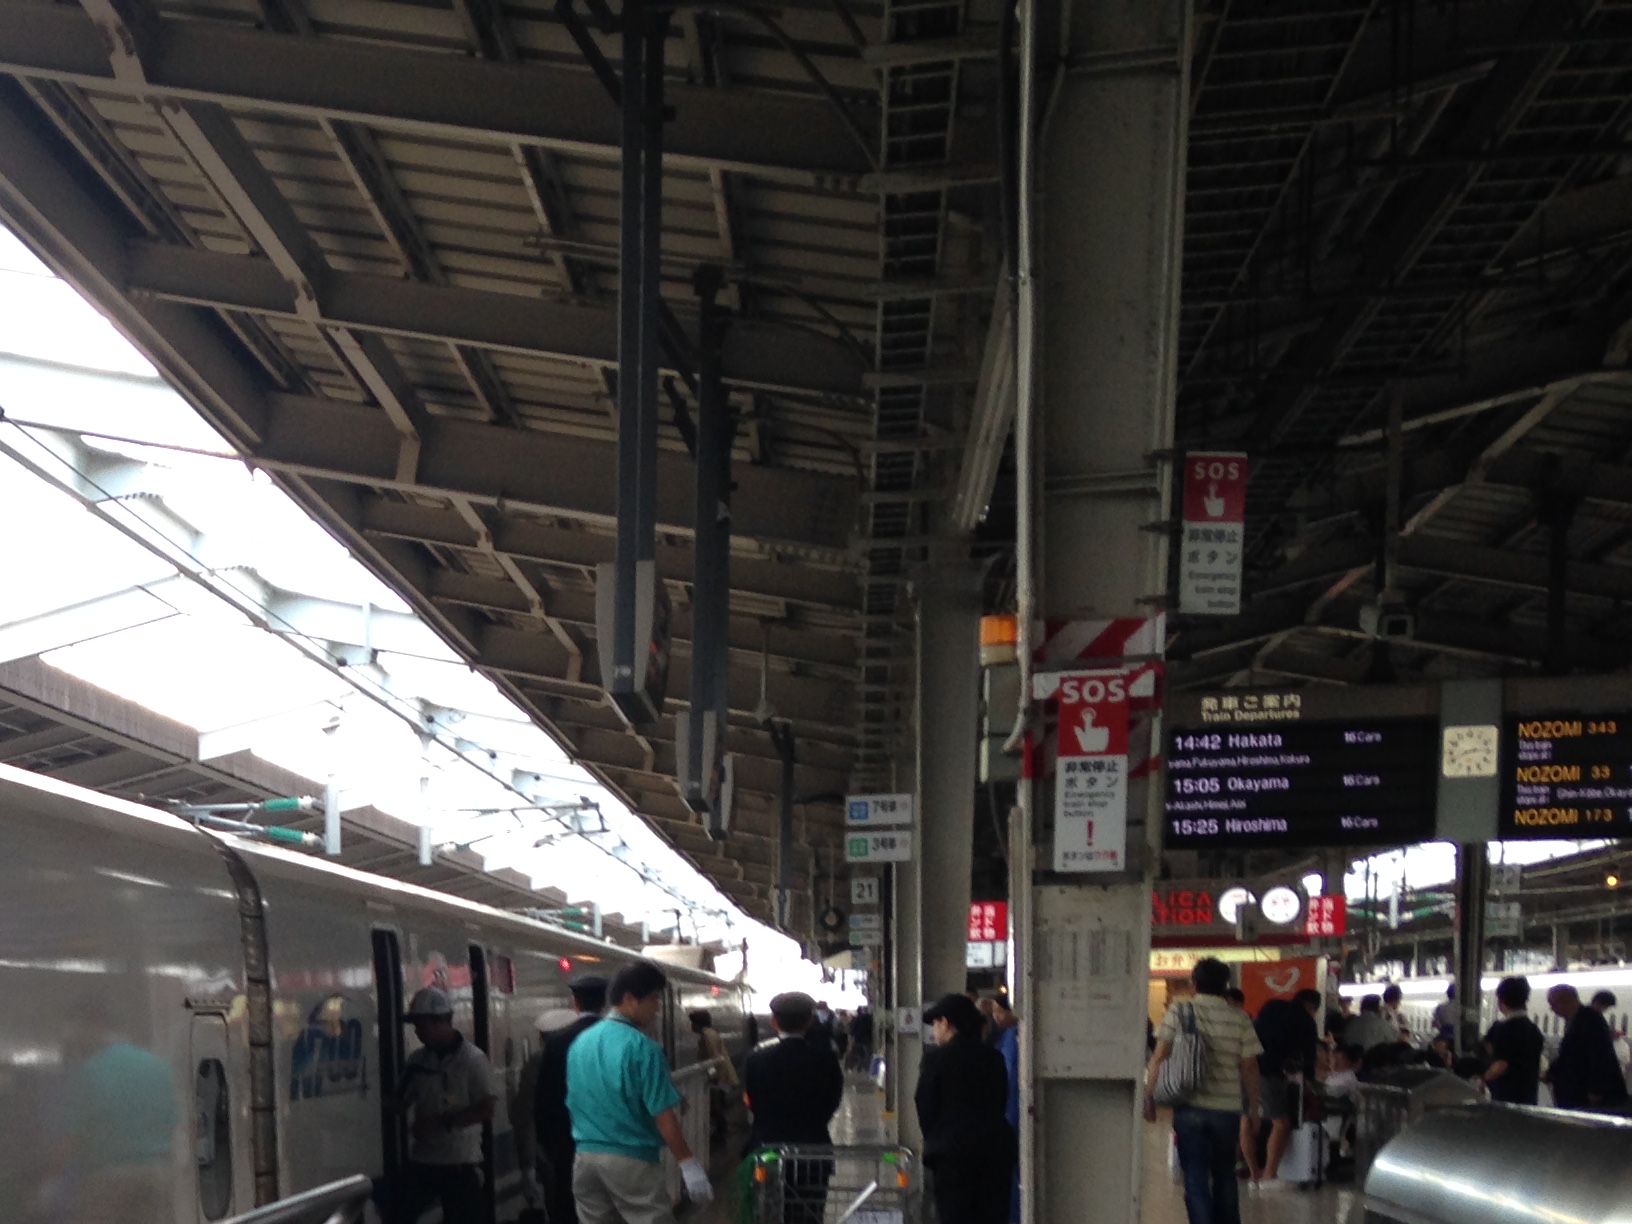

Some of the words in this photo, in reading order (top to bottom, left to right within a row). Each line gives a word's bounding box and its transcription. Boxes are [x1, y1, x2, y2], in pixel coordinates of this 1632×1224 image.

[1195, 462, 1239, 480] SOS
[1062, 679, 1125, 704] SOS
[1202, 710, 1231, 722] Train
[1234, 708, 1301, 721] Departures
[1518, 721, 1582, 739] NOZOMI
[1175, 734, 1221, 751] 14:42
[1228, 733, 1283, 749] Hakata
[1517, 765, 1581, 782] NOZOMI
[1174, 777, 1220, 793] 15:05
[1227, 776, 1289, 792] Okayama
[1172, 818, 1219, 835] 15:25
[1225, 817, 1288, 834] Hiroshima
[1515, 808, 1579, 826] NOZOMI
[857, 883, 873, 899] 21
